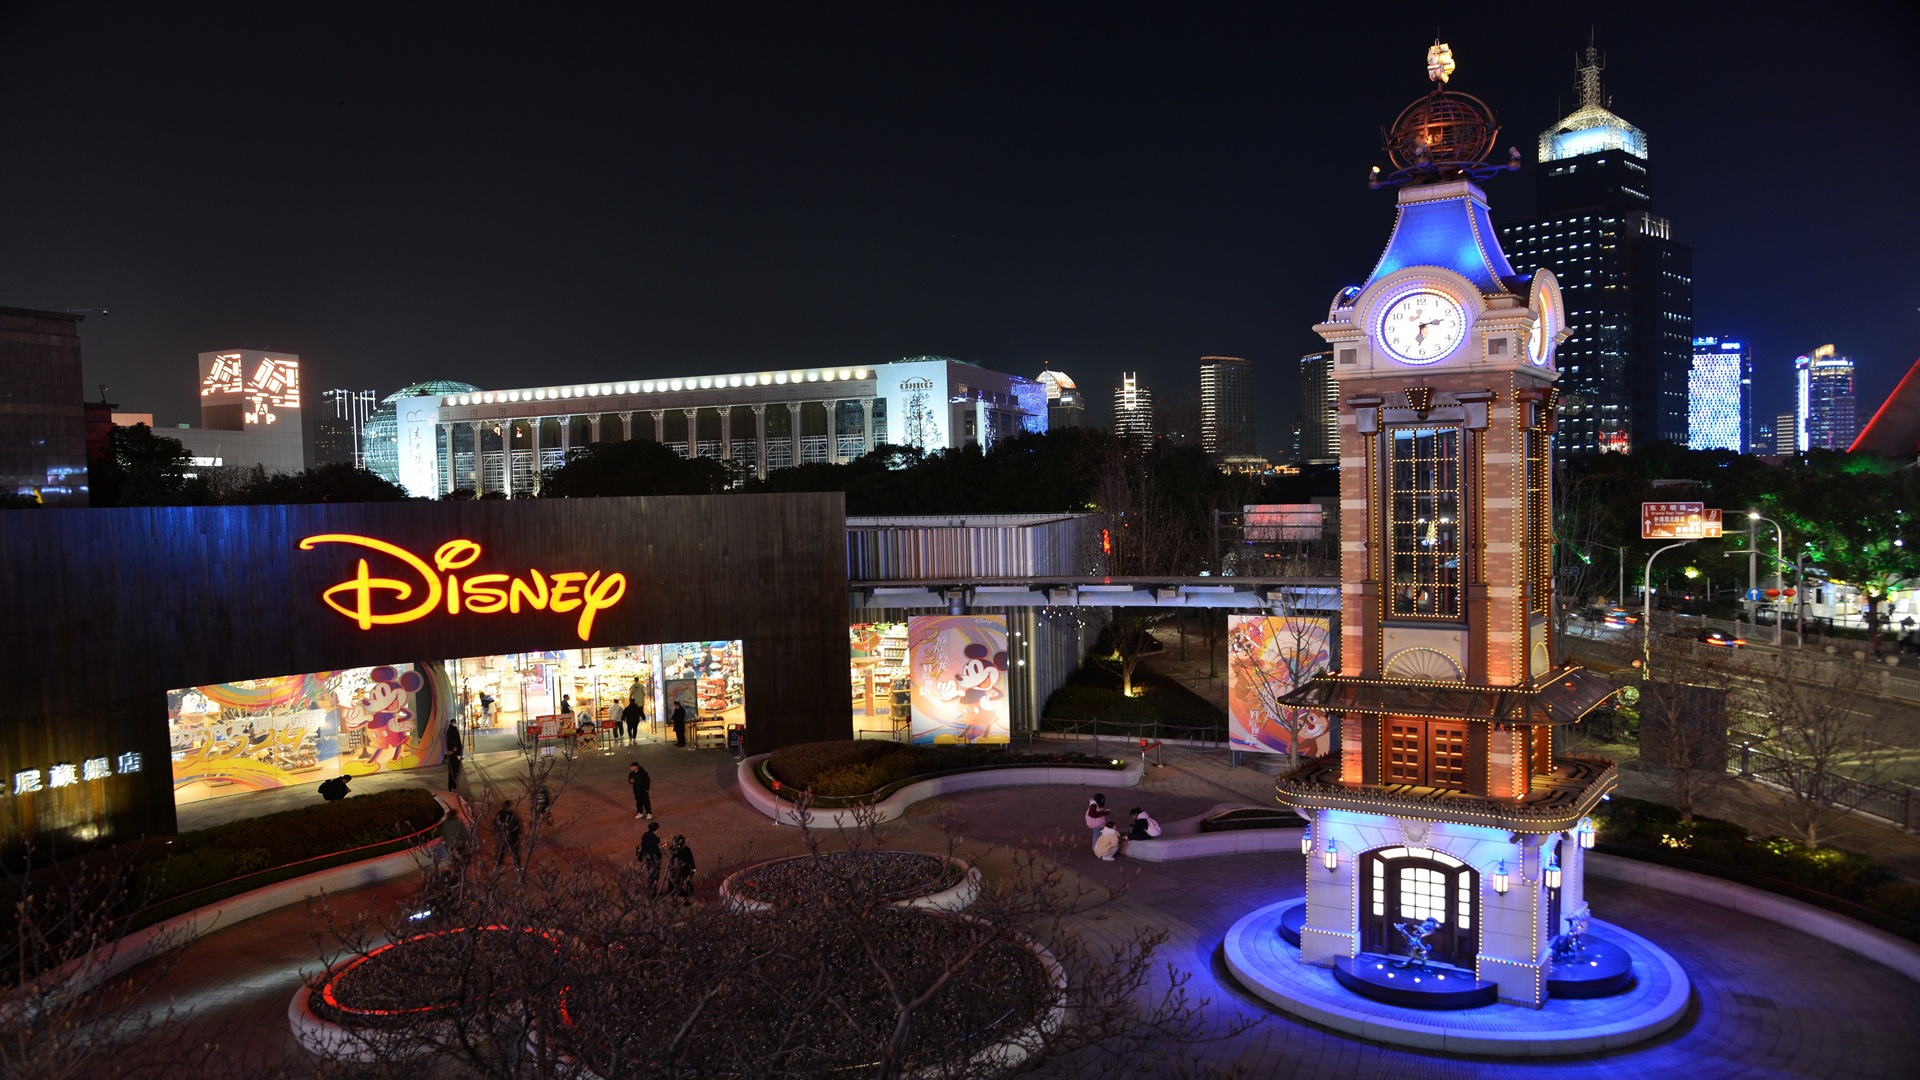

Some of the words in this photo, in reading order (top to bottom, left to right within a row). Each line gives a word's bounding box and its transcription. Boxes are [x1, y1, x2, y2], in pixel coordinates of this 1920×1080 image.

[1416, 298, 1427, 306] 12
[1393, 337, 1400, 345] 8
[1419, 348, 1426, 356] 6
[0, 751, 143, 798] 尼旗舰店
